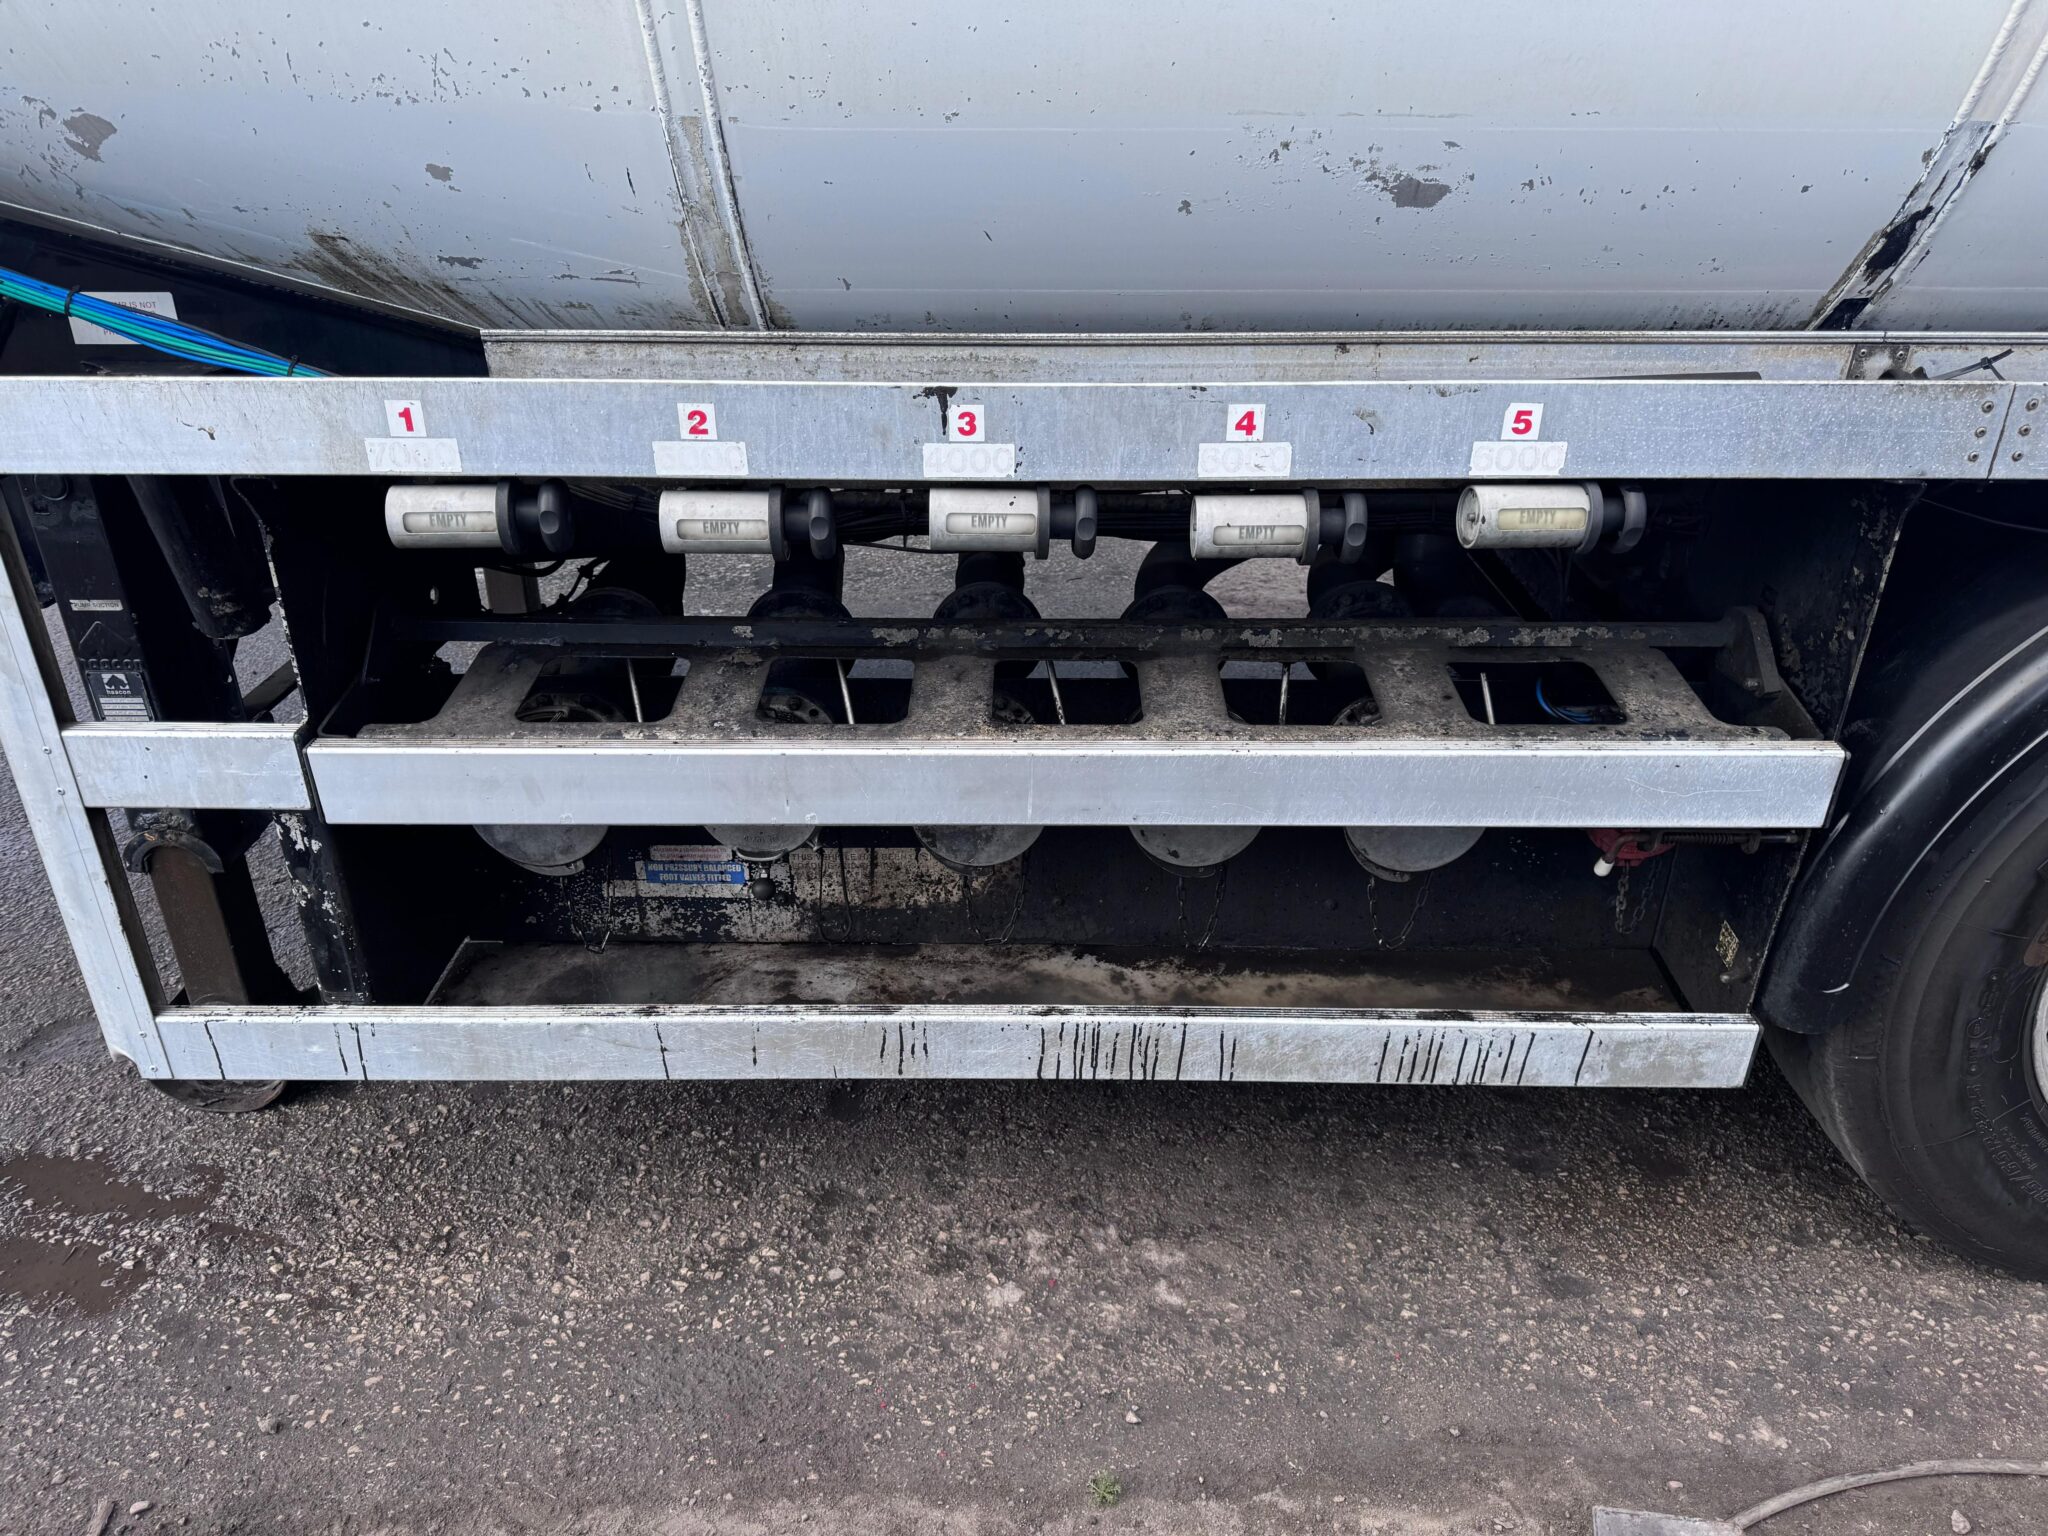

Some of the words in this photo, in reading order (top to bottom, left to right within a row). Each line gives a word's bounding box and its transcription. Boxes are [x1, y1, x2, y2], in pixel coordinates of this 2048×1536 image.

[139, 301, 157, 309] NOT
[398, 407, 415, 432] 1
[687, 410, 709, 435] 2
[957, 411, 977, 436] 3
[1234, 410, 1257, 436] 4
[1511, 410, 1533, 435] 5
[429, 513, 468, 528] EMPTY
[970, 515, 1009, 529] EMPTY
[1519, 509, 1558, 525] EMPTY
[702, 521, 740, 534] EMPTY
[1238, 526, 1277, 540] EMPTY
[703, 864, 741, 872] BALANCED
